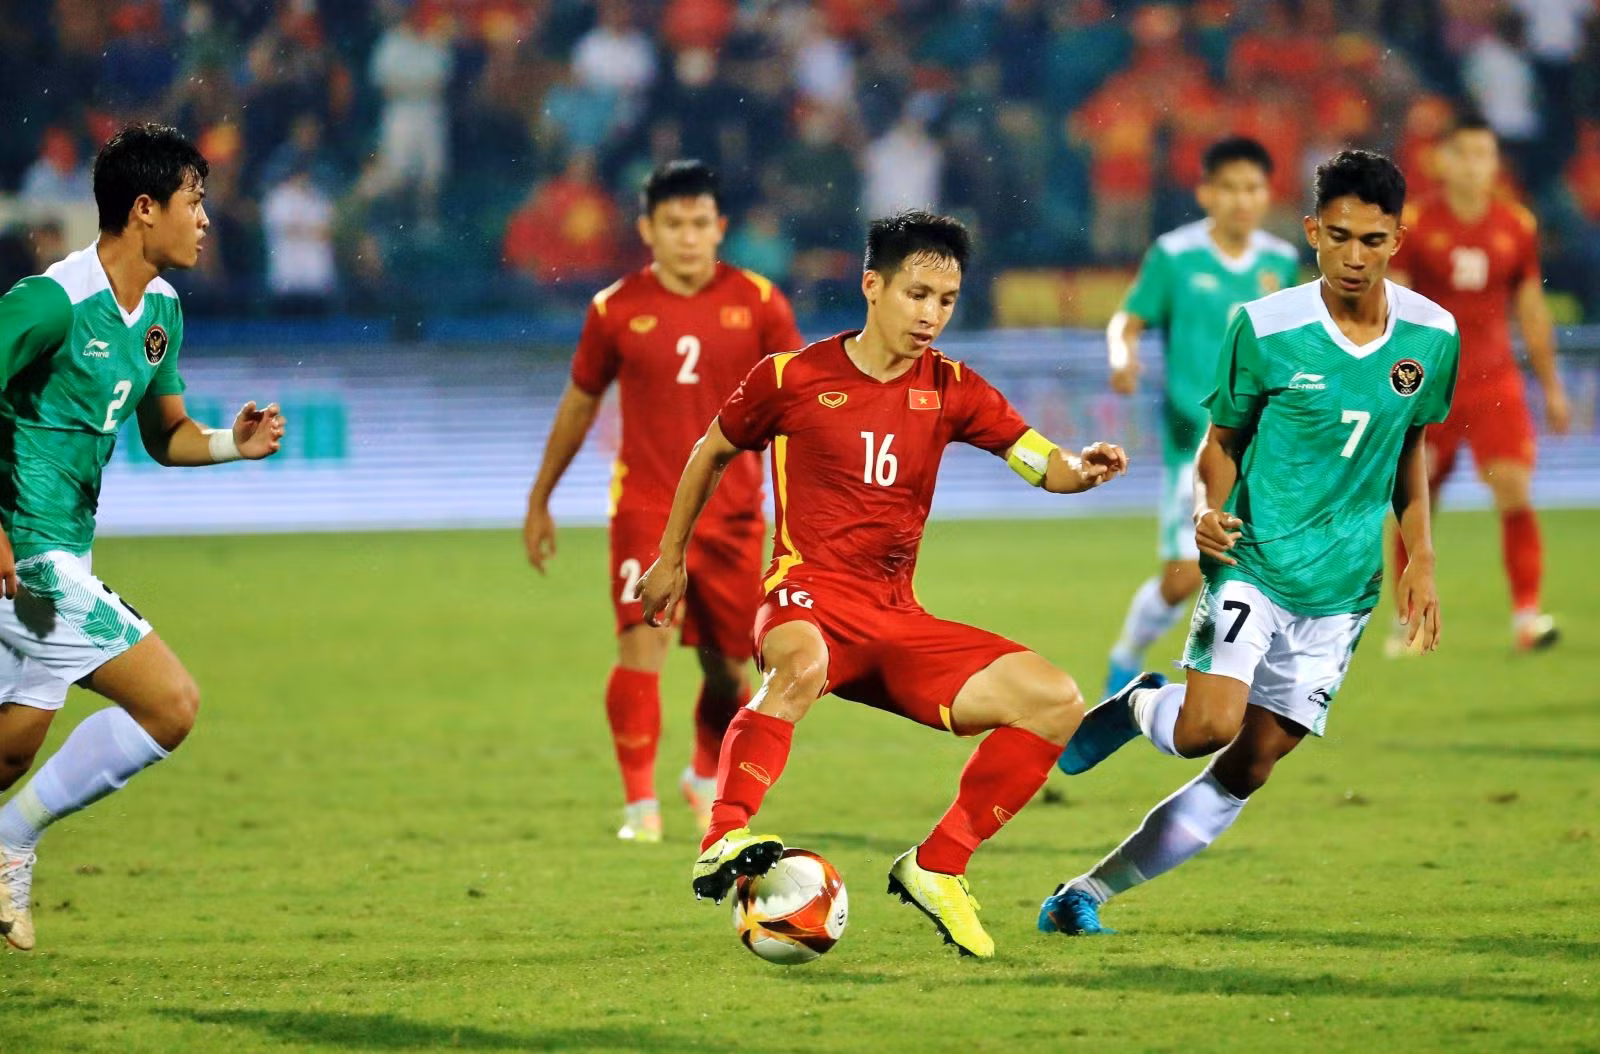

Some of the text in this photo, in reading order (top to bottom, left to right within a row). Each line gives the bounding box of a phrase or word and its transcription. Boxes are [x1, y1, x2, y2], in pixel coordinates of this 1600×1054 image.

[676, 335, 701, 384] 2
[103, 380, 132, 431] 2
[860, 431, 898, 487] 16
[1340, 410, 1371, 459] 7
[1223, 600, 1252, 644] 7
